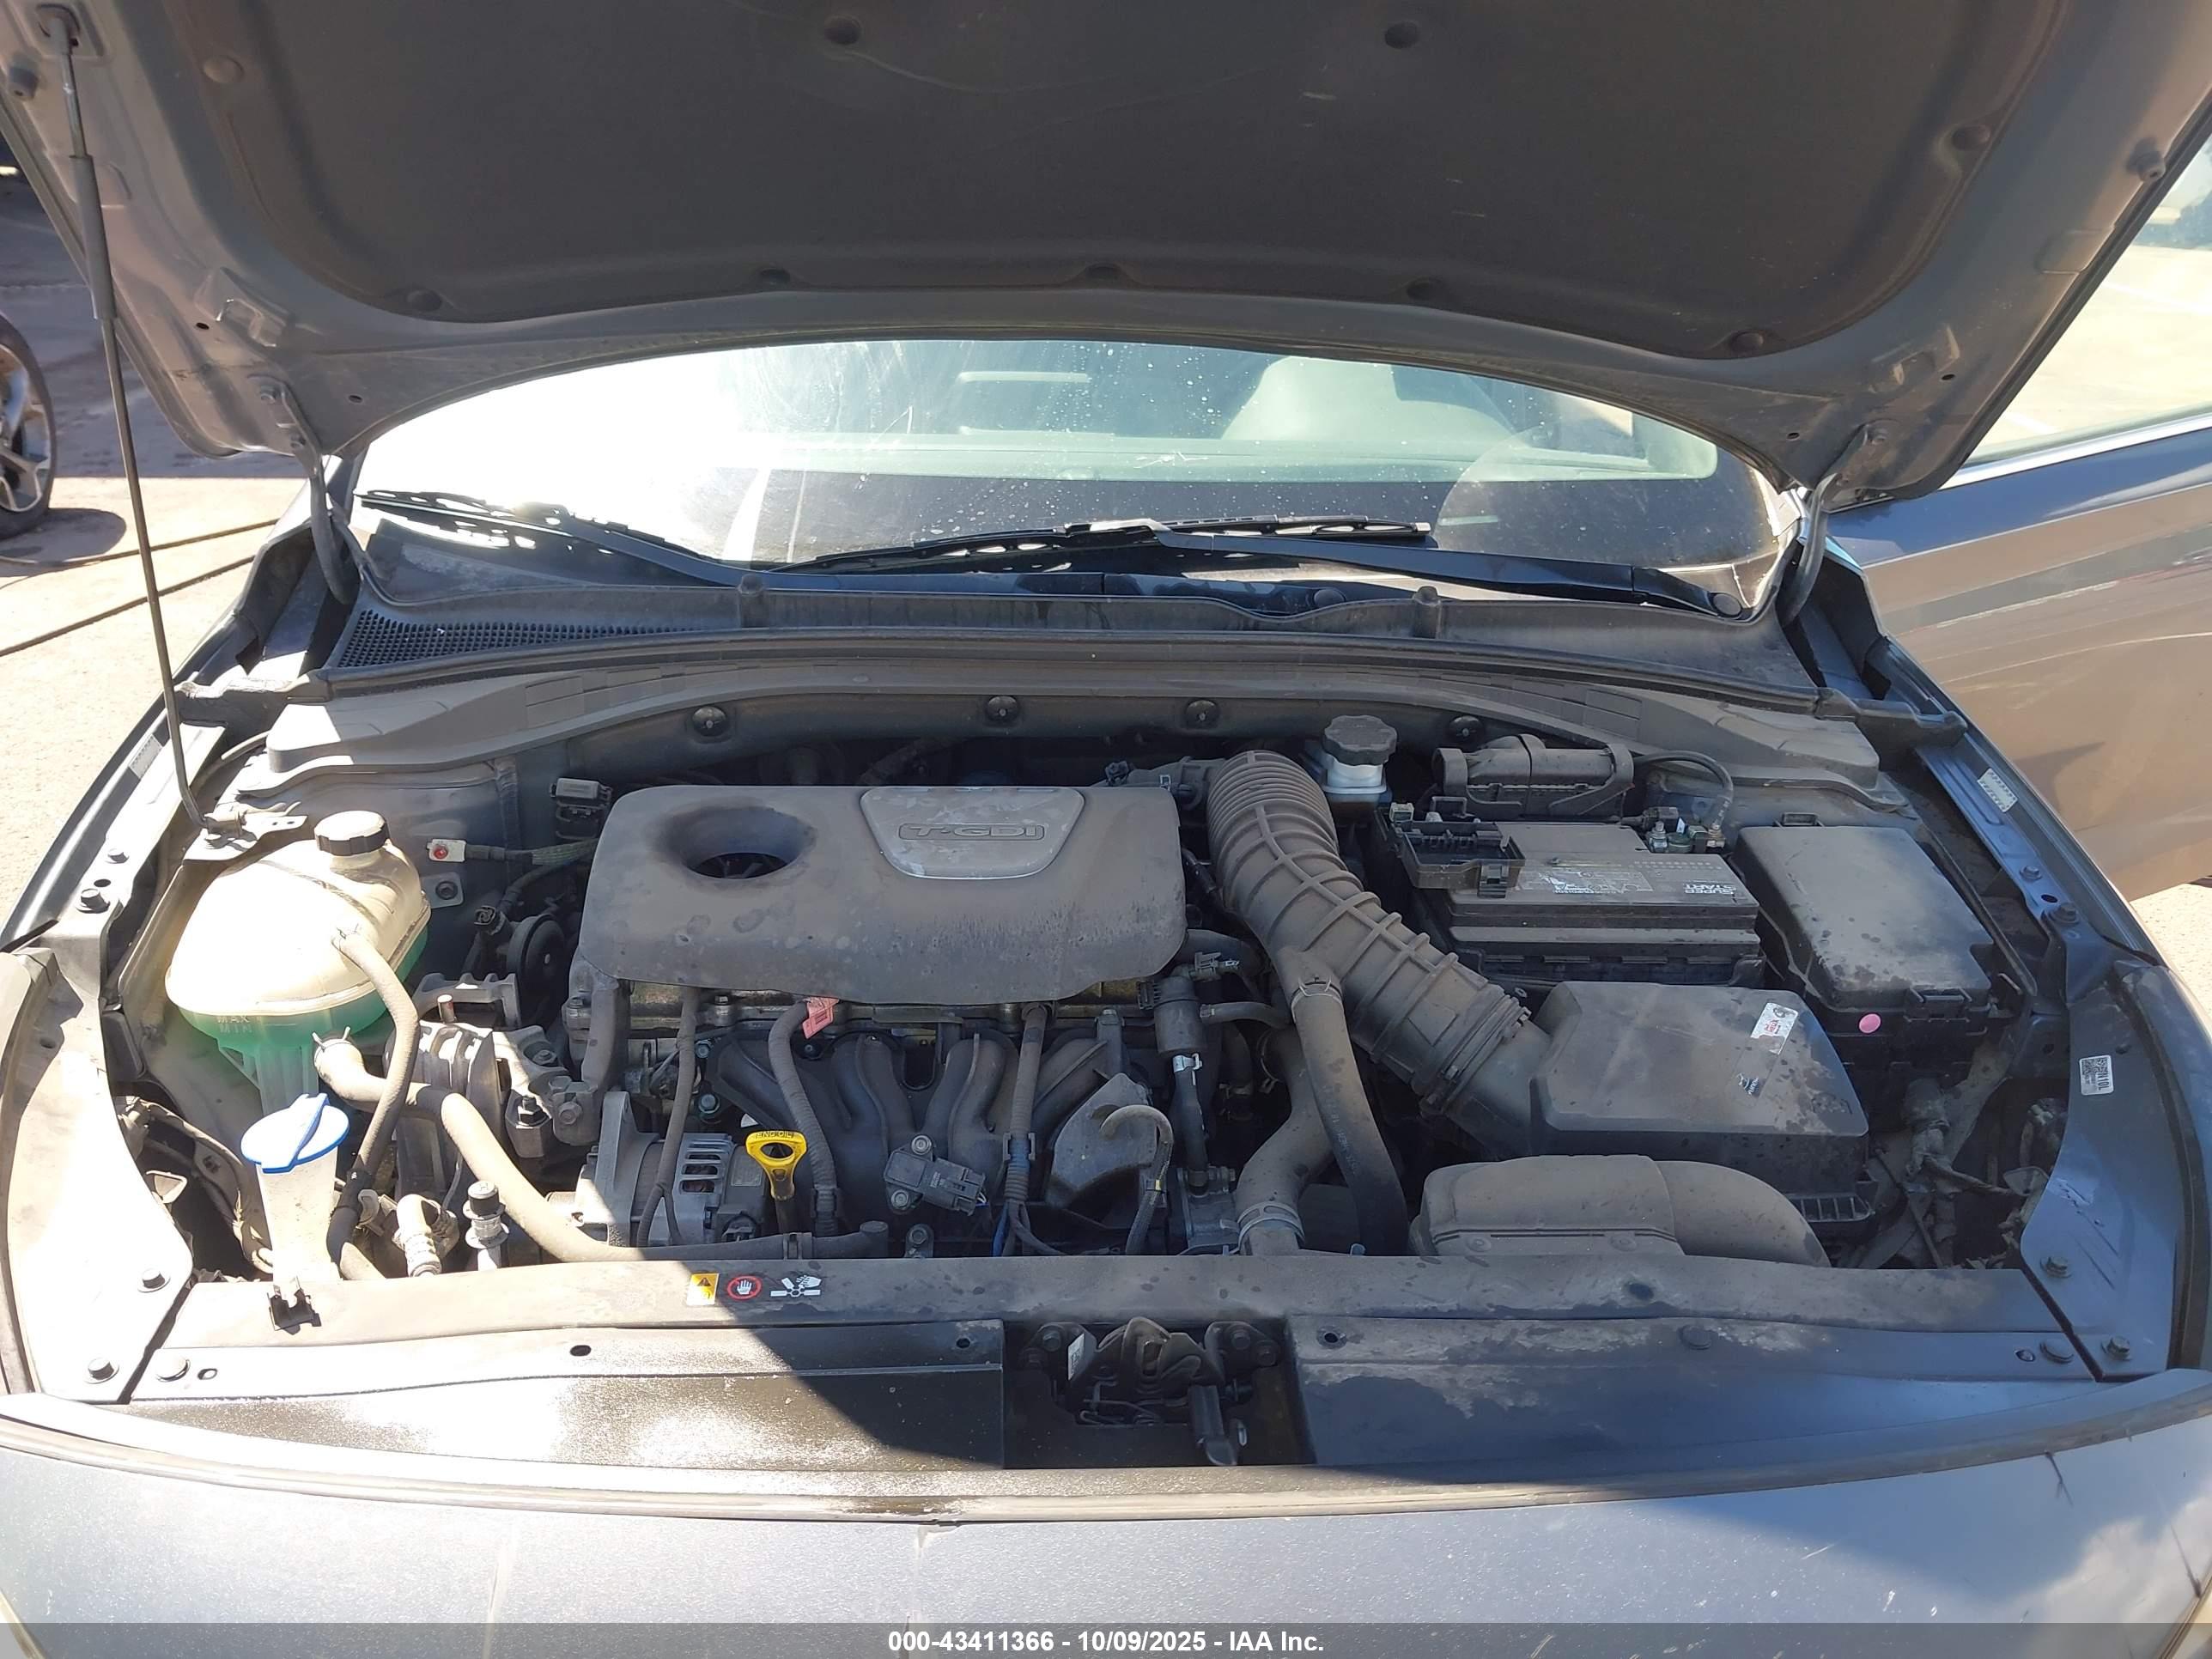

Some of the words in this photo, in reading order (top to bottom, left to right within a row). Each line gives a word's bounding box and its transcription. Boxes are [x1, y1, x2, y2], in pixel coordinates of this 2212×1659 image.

[216, 1015, 251, 1024] MAX
[219, 1024, 252, 1033] MIN
[778, 1131, 793, 1139] OIL
